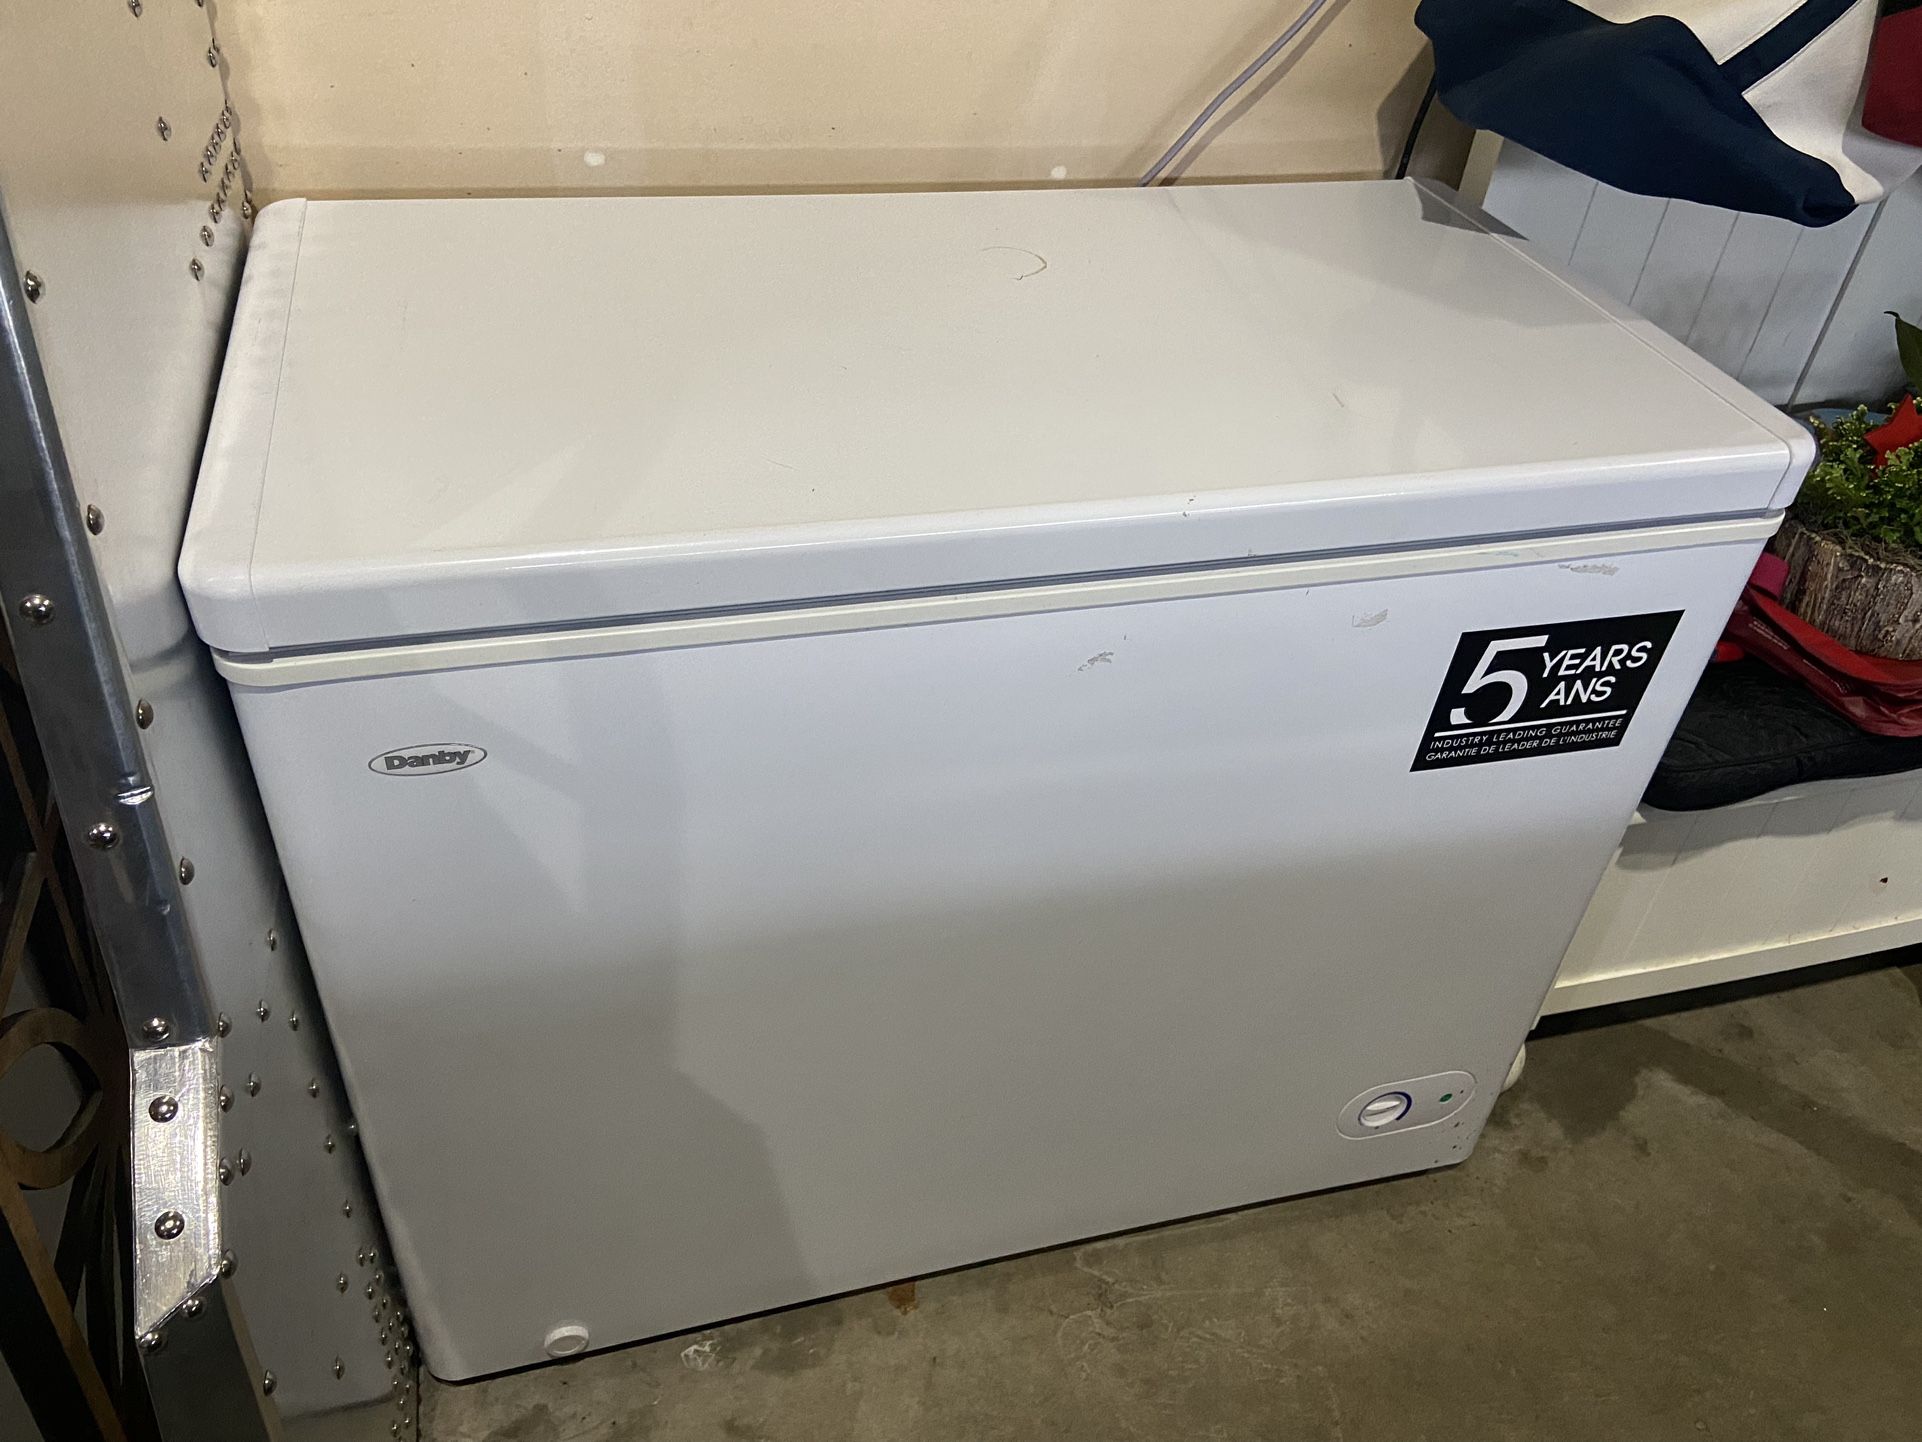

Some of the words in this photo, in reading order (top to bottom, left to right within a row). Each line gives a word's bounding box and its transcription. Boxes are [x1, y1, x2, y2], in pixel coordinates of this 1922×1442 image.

[1450, 634, 1549, 725] 5
[1542, 641, 1652, 678] YEARS
[1540, 676, 1616, 708] ANS
[1426, 747, 1478, 761] GARANTIE
[1481, 745, 1496, 754] DE
[1499, 740, 1540, 752] LEADER
[1542, 737, 1558, 747] DE
[1560, 730, 1618, 744] L'INDUSTRIE
[1430, 735, 1489, 749] INDUSTRY
[1493, 728, 1546, 742] LEADING
[1552, 718, 1623, 734] GUARANTEE
[384, 750, 471, 770] Danby
